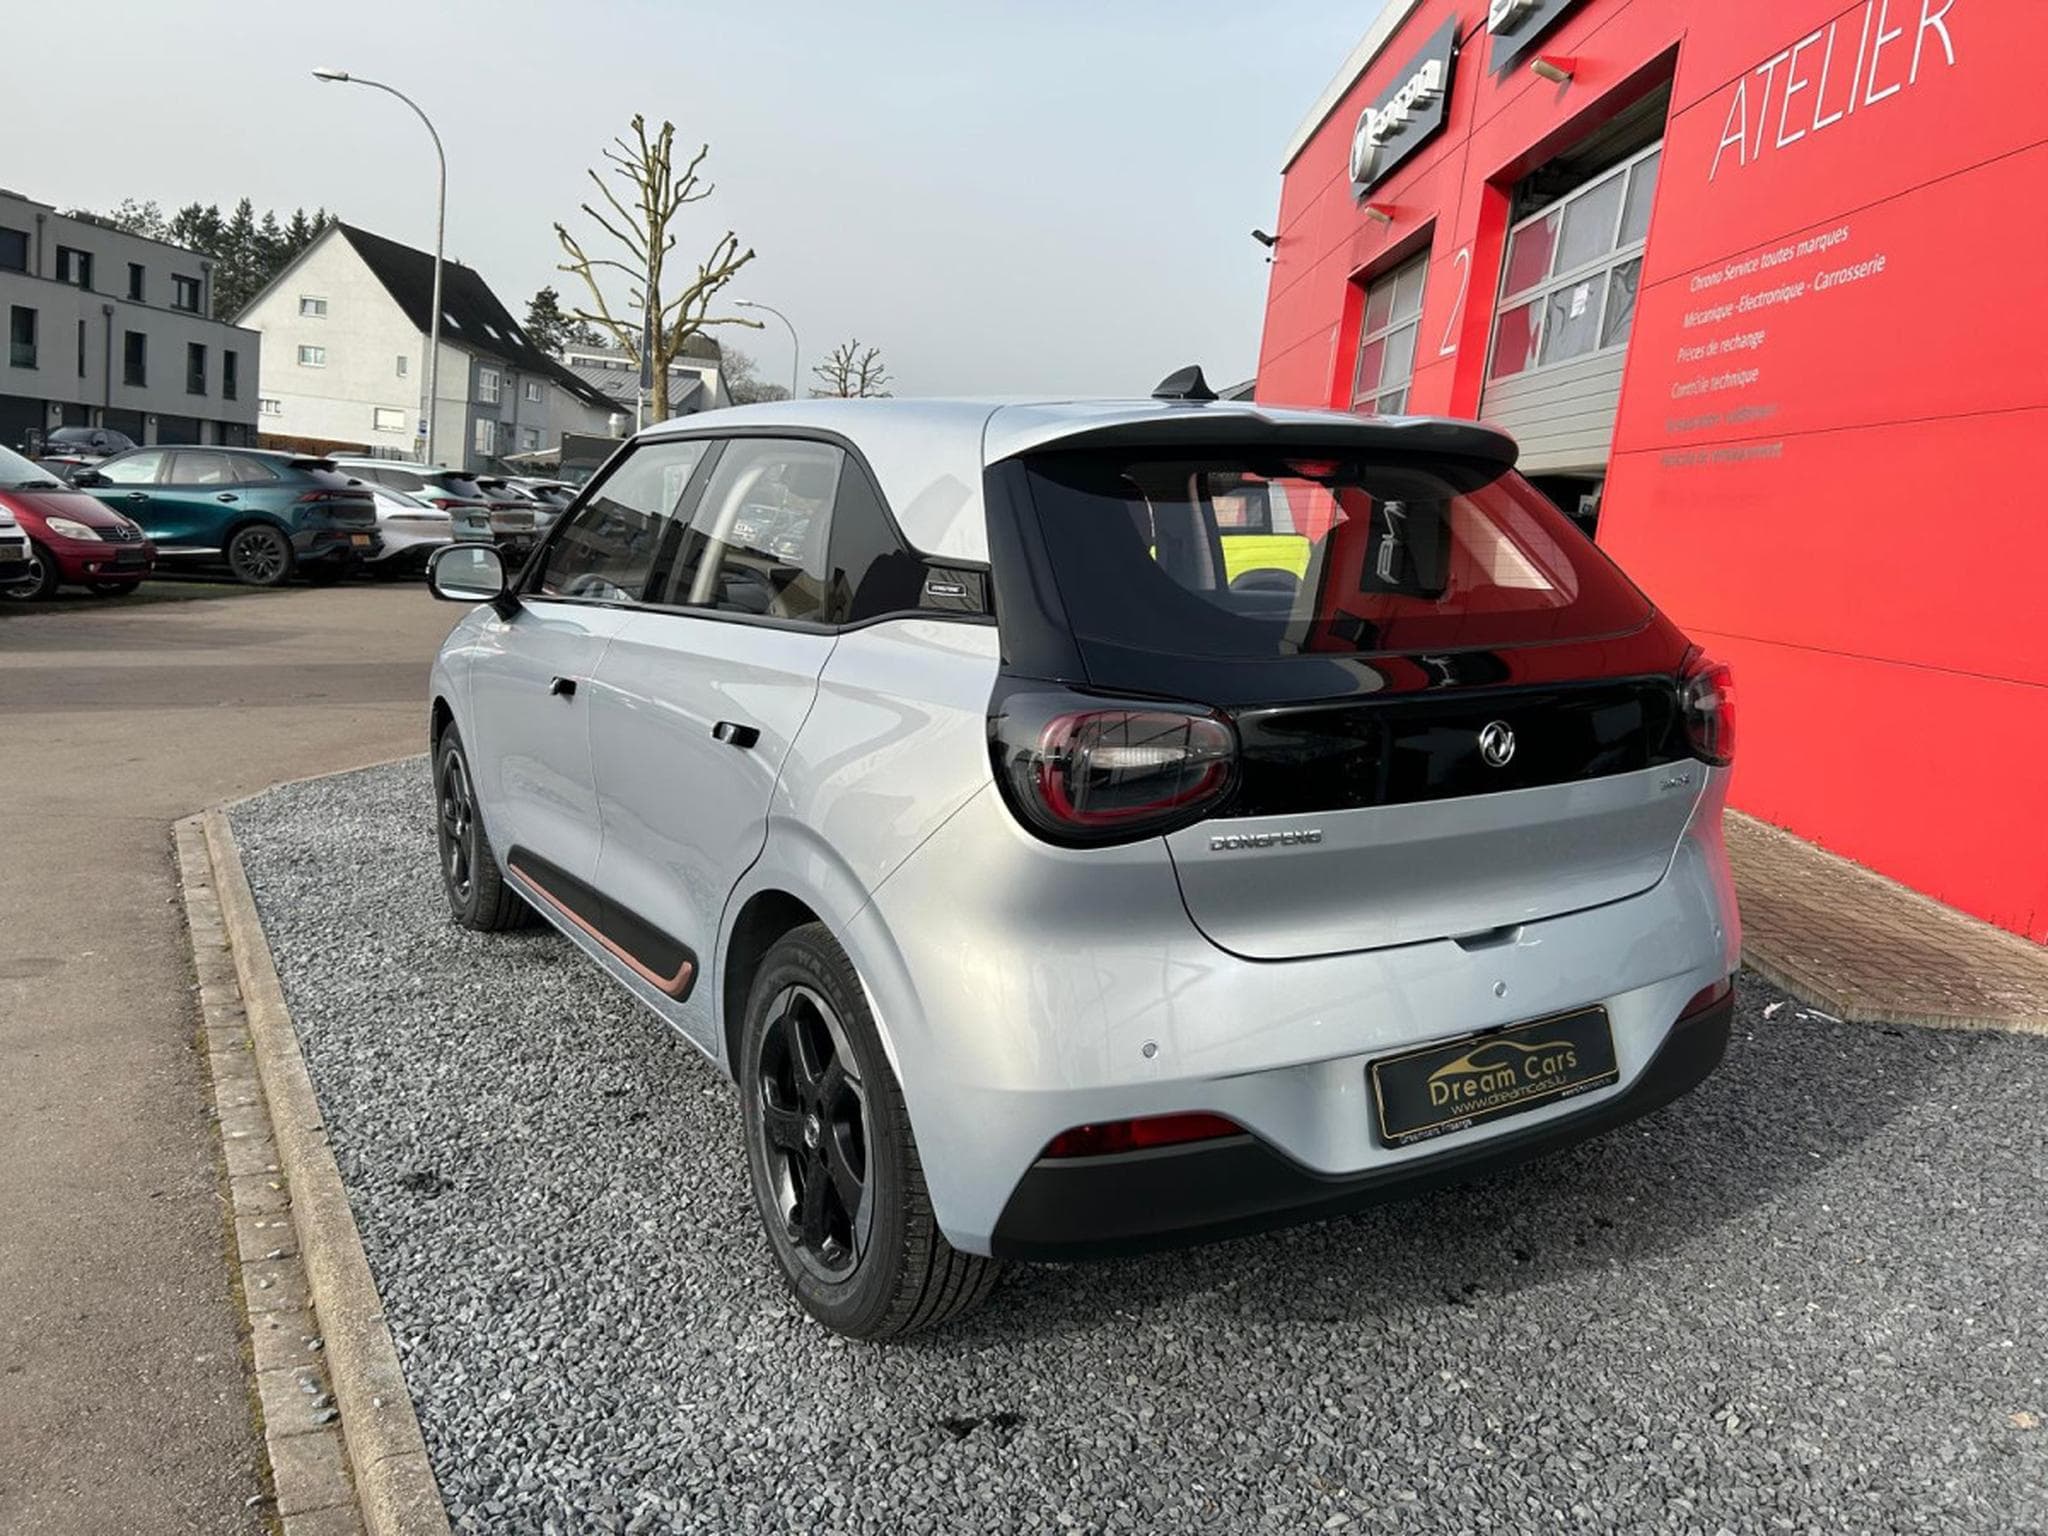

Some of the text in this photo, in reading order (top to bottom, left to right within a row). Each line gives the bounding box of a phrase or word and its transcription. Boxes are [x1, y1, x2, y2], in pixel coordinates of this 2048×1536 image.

[1708, 0, 1955, 183] ATELIER
[1690, 225, 1849, 293] Chrono Service toutes marques
[1814, 254, 1886, 291] Carrosserie
[1440, 248, 1470, 356] 2
[1706, 339, 1719, 356] de
[1721, 330, 1765, 352] rechange
[1711, 367, 1759, 391] technique
[1211, 829, 1321, 851] DONGFENG
[1429, 1050, 1578, 1106] Dream Cars
